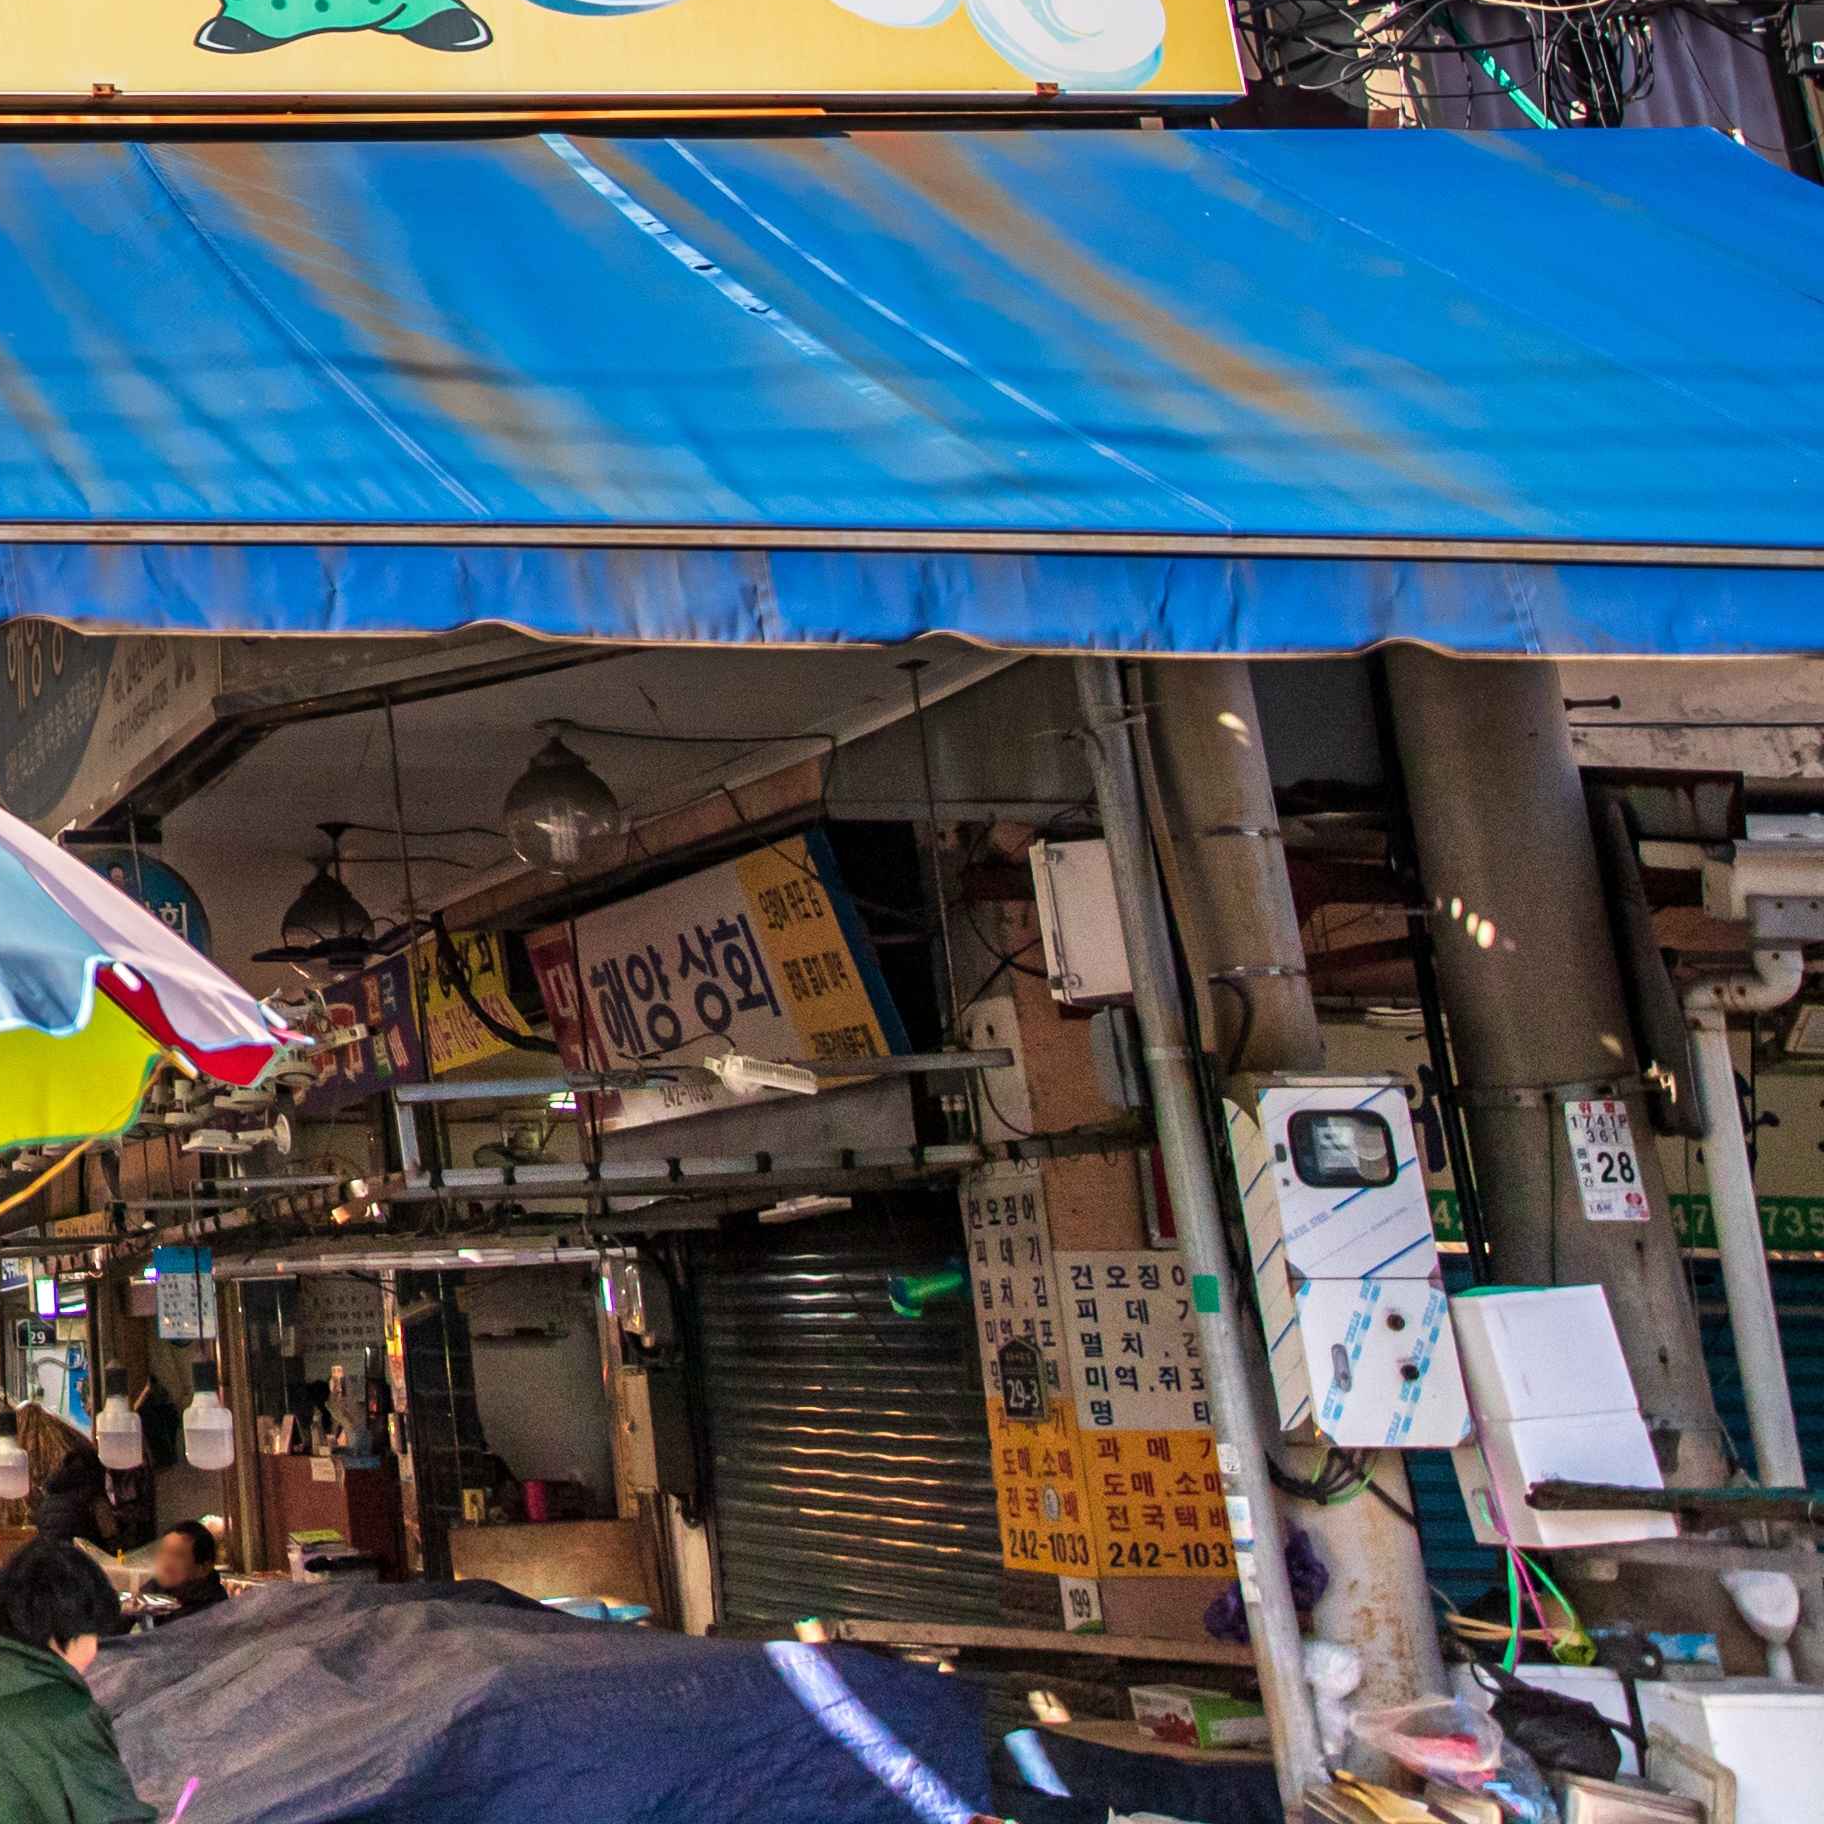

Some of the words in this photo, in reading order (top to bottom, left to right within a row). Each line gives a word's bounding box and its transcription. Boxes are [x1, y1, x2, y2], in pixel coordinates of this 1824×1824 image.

[1597, 1151, 1636, 1184] 28
[1006, 1377, 1041, 1409] 29-3
[1005, 1487, 1080, 1524] 전국배
[1007, 1529, 1090, 1566] 242-1033
[1108, 1541, 1236, 1569] 242-103
